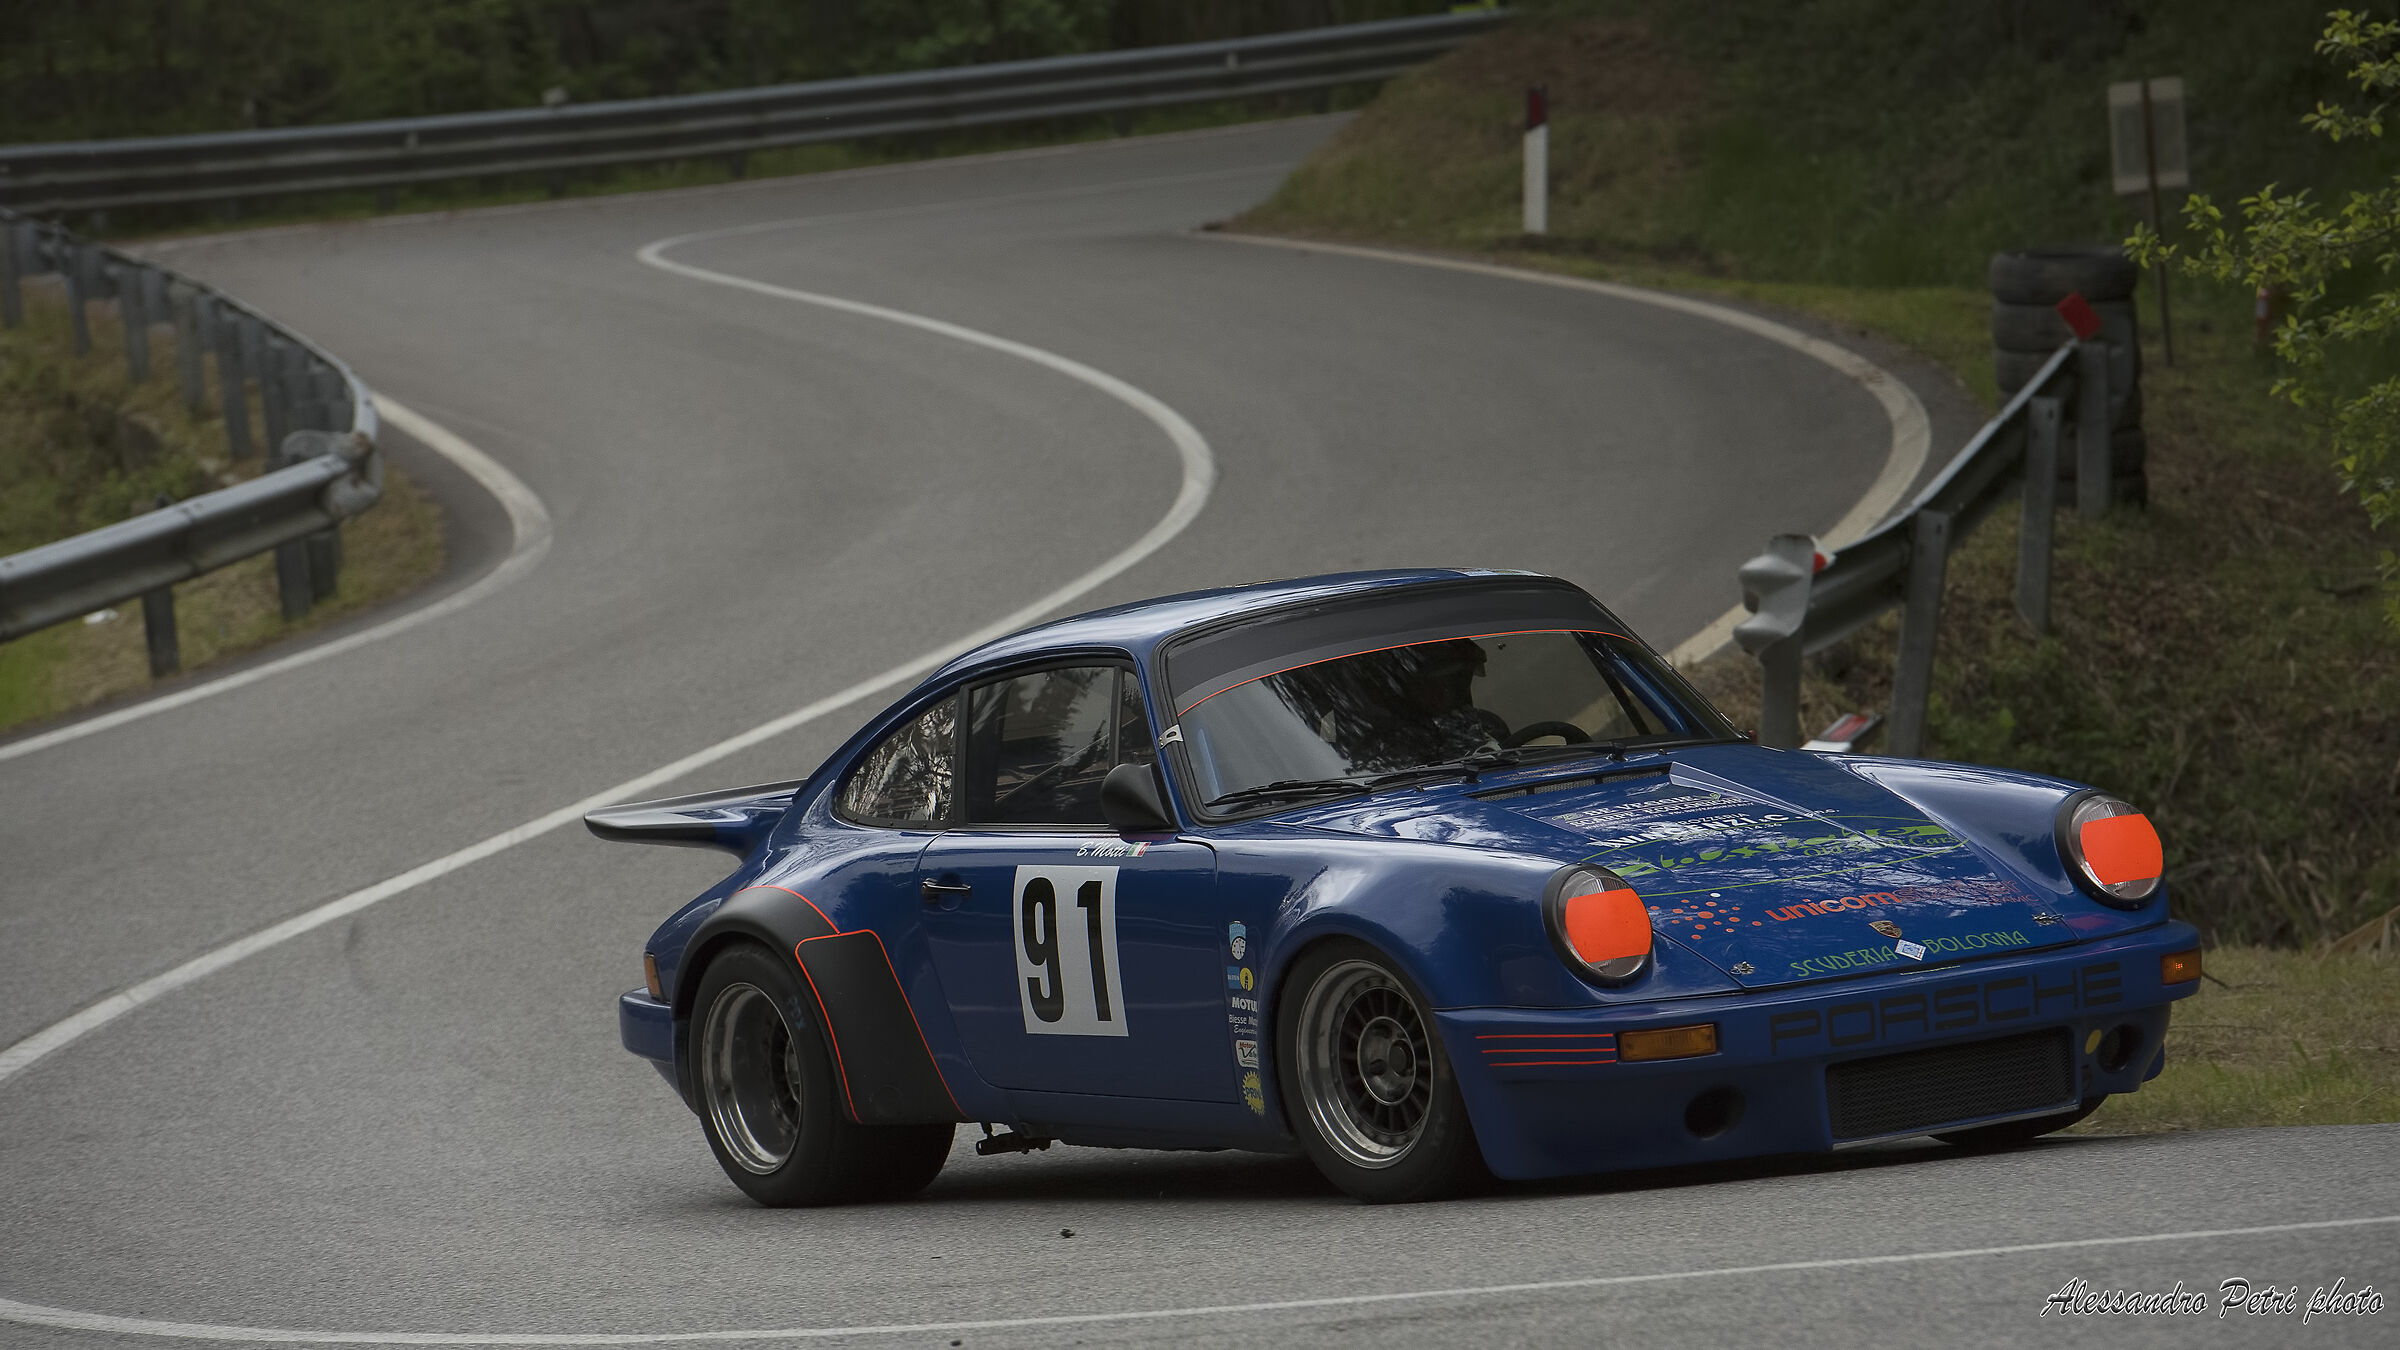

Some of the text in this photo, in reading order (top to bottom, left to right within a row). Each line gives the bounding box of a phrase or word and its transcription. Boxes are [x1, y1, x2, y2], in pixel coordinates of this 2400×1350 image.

[1021, 876, 1113, 1023] 91
[1790, 945, 1896, 977] SCUDERIA
[1923, 929, 2030, 955] BOLOGNA
[1771, 962, 2123, 1055] PORSCHE
